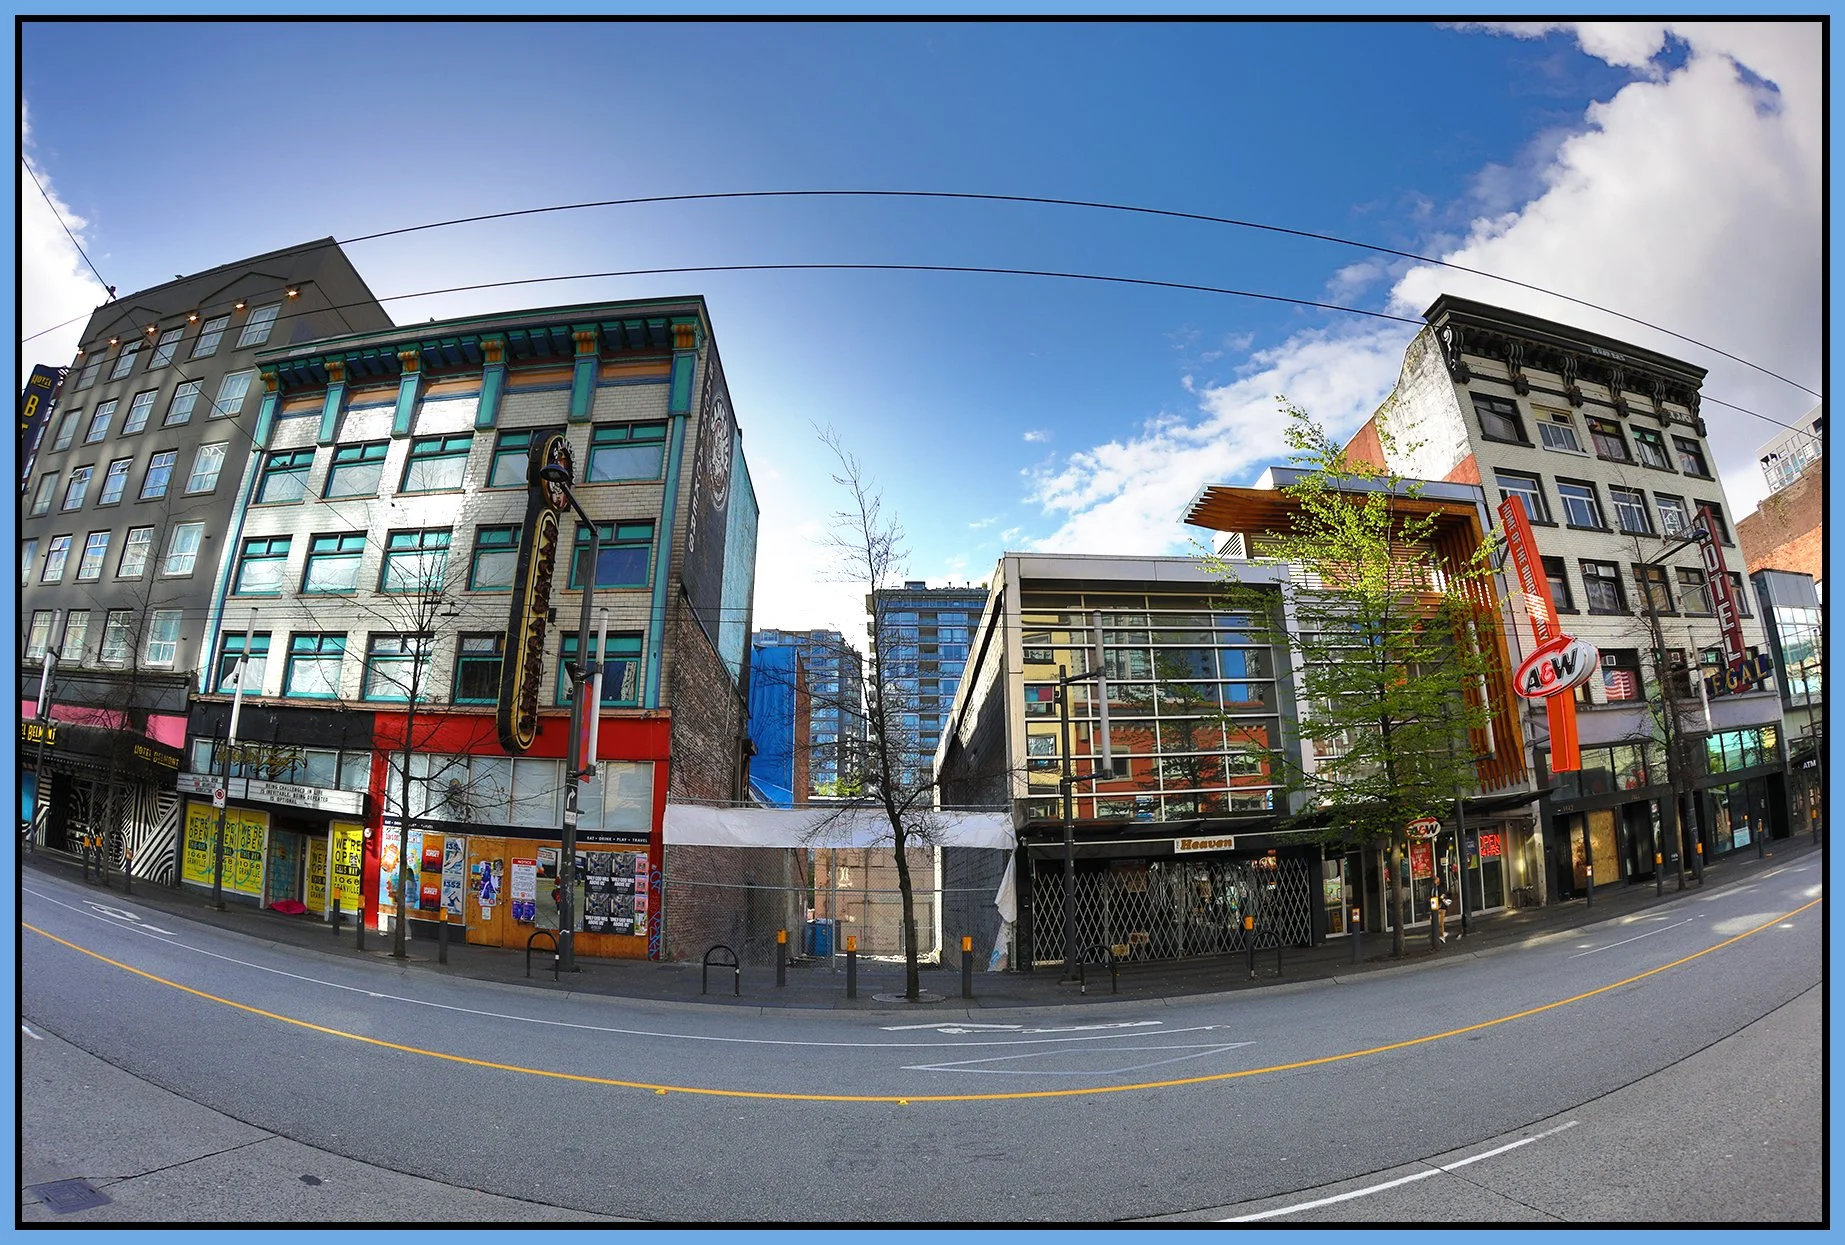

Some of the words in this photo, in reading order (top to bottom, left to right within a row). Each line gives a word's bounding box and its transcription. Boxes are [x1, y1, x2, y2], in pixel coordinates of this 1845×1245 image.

[31, 374, 52, 387] HOTEL
[1502, 503, 1517, 531] HOME
[1511, 531, 1521, 545] OF
[1515, 544, 1528, 564] THE
[1521, 564, 1538, 601] BURGE
[1524, 647, 1578, 694] A&W
[1705, 657, 1767, 696] EGAL
[27, 725, 57, 741] BELMNT
[134, 744, 151, 757] HOTEL
[153, 752, 180, 767] BELMONT
[1803, 760, 1816, 770] ATM
[279, 784, 305, 794] CHALLENGED
[189, 828, 208, 841] OPEN
[241, 837, 260, 850] OPEN
[335, 838, 361, 851] WE'RE
[1181, 839, 1232, 850] Heaven
[188, 851, 206, 859] 1068
[239, 861, 260, 869] 1068
[348, 866, 359, 876] WAY
[334, 877, 360, 885] 1068
